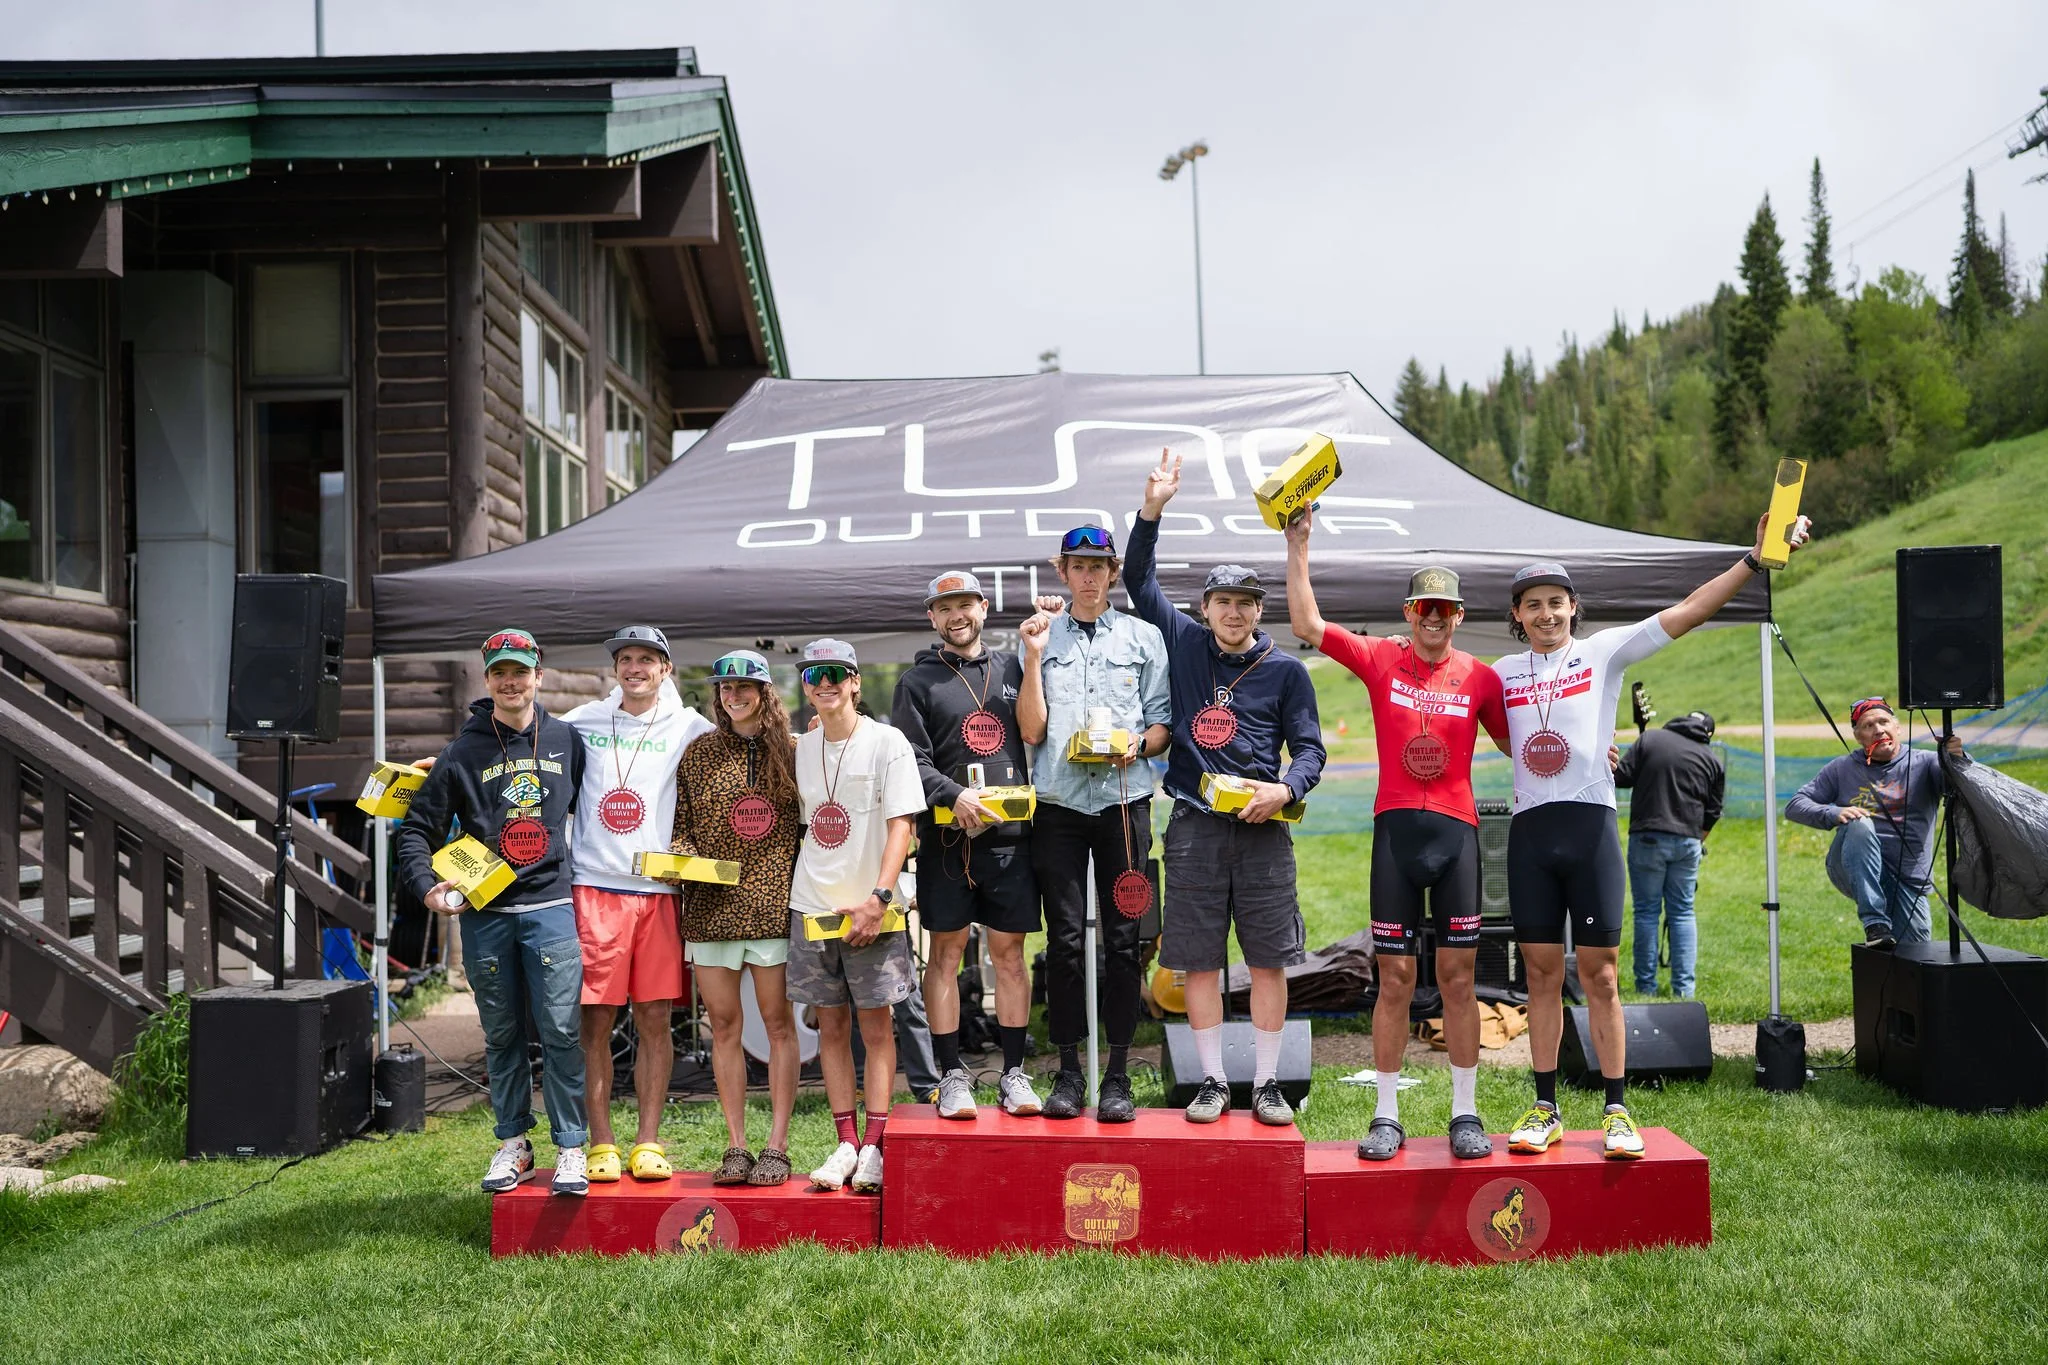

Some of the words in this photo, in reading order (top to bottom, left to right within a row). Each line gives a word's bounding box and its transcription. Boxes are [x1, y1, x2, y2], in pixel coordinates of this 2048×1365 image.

[1296, 464, 1329, 502] STINGER
[1510, 672, 1585, 696] STEAMBOAT
[1398, 683, 1466, 703] STEAMBOAT
[588, 732, 667, 753] tailwind
[1409, 747, 1442, 755] OUTLAW
[606, 801, 638, 810] OUTLAW
[816, 816, 844, 824] OUTLAW
[507, 831, 541, 840] OUTLAW
[511, 839, 538, 847] GRAVEL
[449, 846, 479, 869] STINGER
[1084, 1218, 1119, 1230] OUTLAW
[1086, 1230, 1116, 1241] GRAVEL
